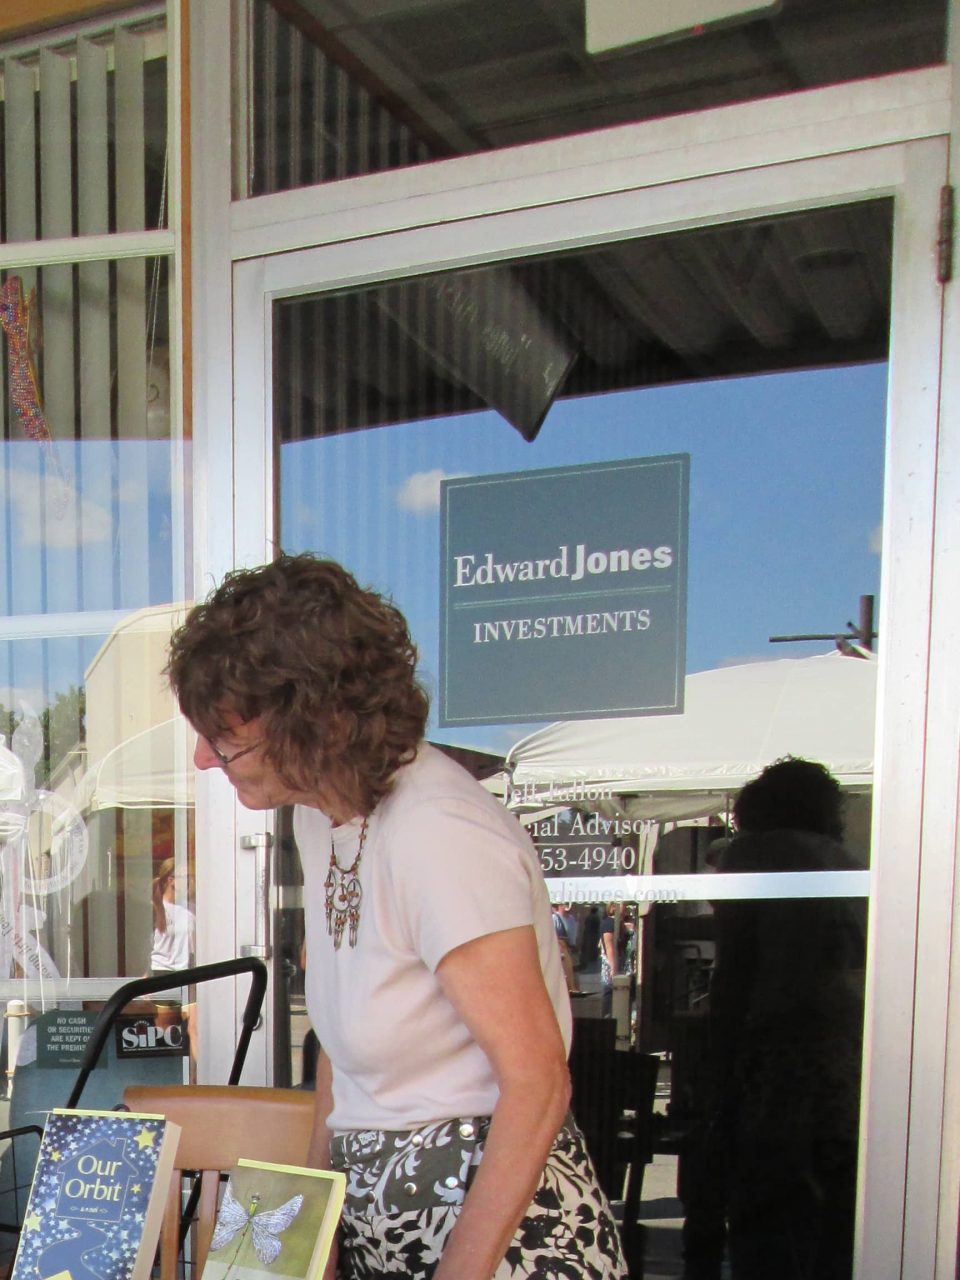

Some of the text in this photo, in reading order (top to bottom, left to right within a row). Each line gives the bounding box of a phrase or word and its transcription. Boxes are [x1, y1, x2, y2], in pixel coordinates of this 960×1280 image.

[473, 608, 651, 643] INVESTMENTS
[568, 812, 656, 837] Advisor
[540, 847, 636, 871] 53-4940
[58, 1026, 94, 1034] SECURITIE
[68, 1017, 87, 1025] CASH
[77, 1154, 123, 1177] Our
[64, 1178, 122, 1201] Orbit
